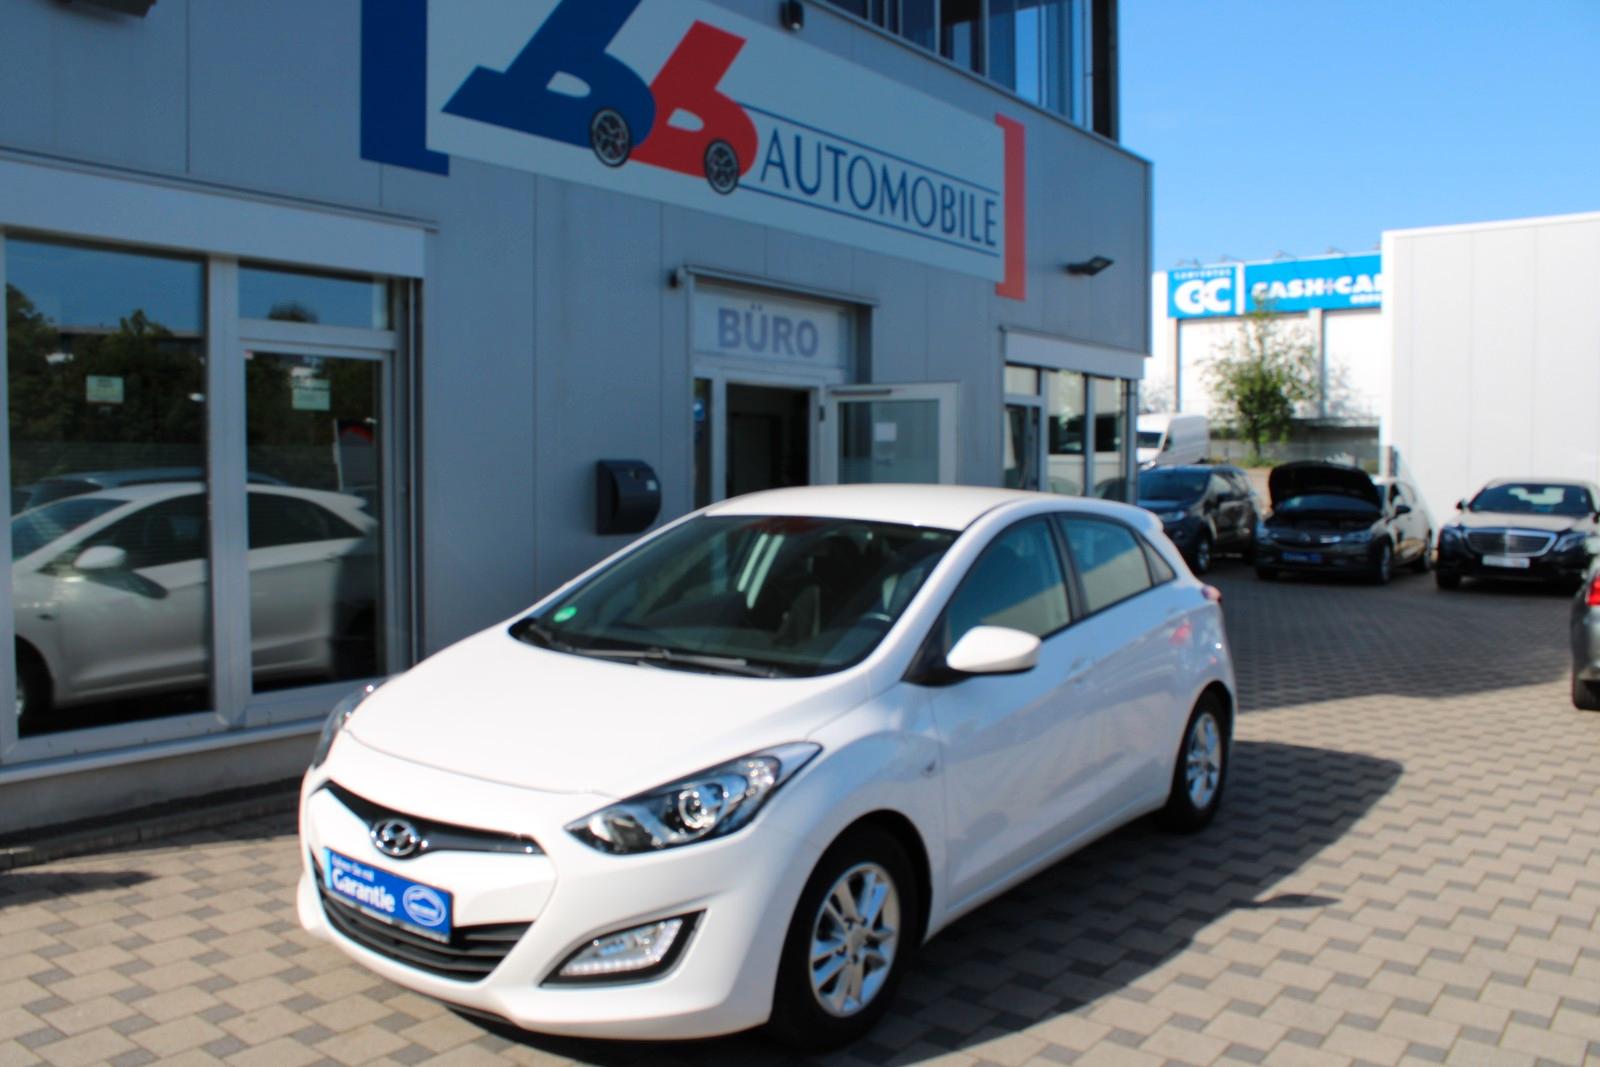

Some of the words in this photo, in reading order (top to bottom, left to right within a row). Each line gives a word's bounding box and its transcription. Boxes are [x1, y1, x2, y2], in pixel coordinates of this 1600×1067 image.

[760, 127, 997, 248] AUTOMOBILE
[717, 303, 820, 358] BÜRO
[332, 868, 396, 913] Garantie
